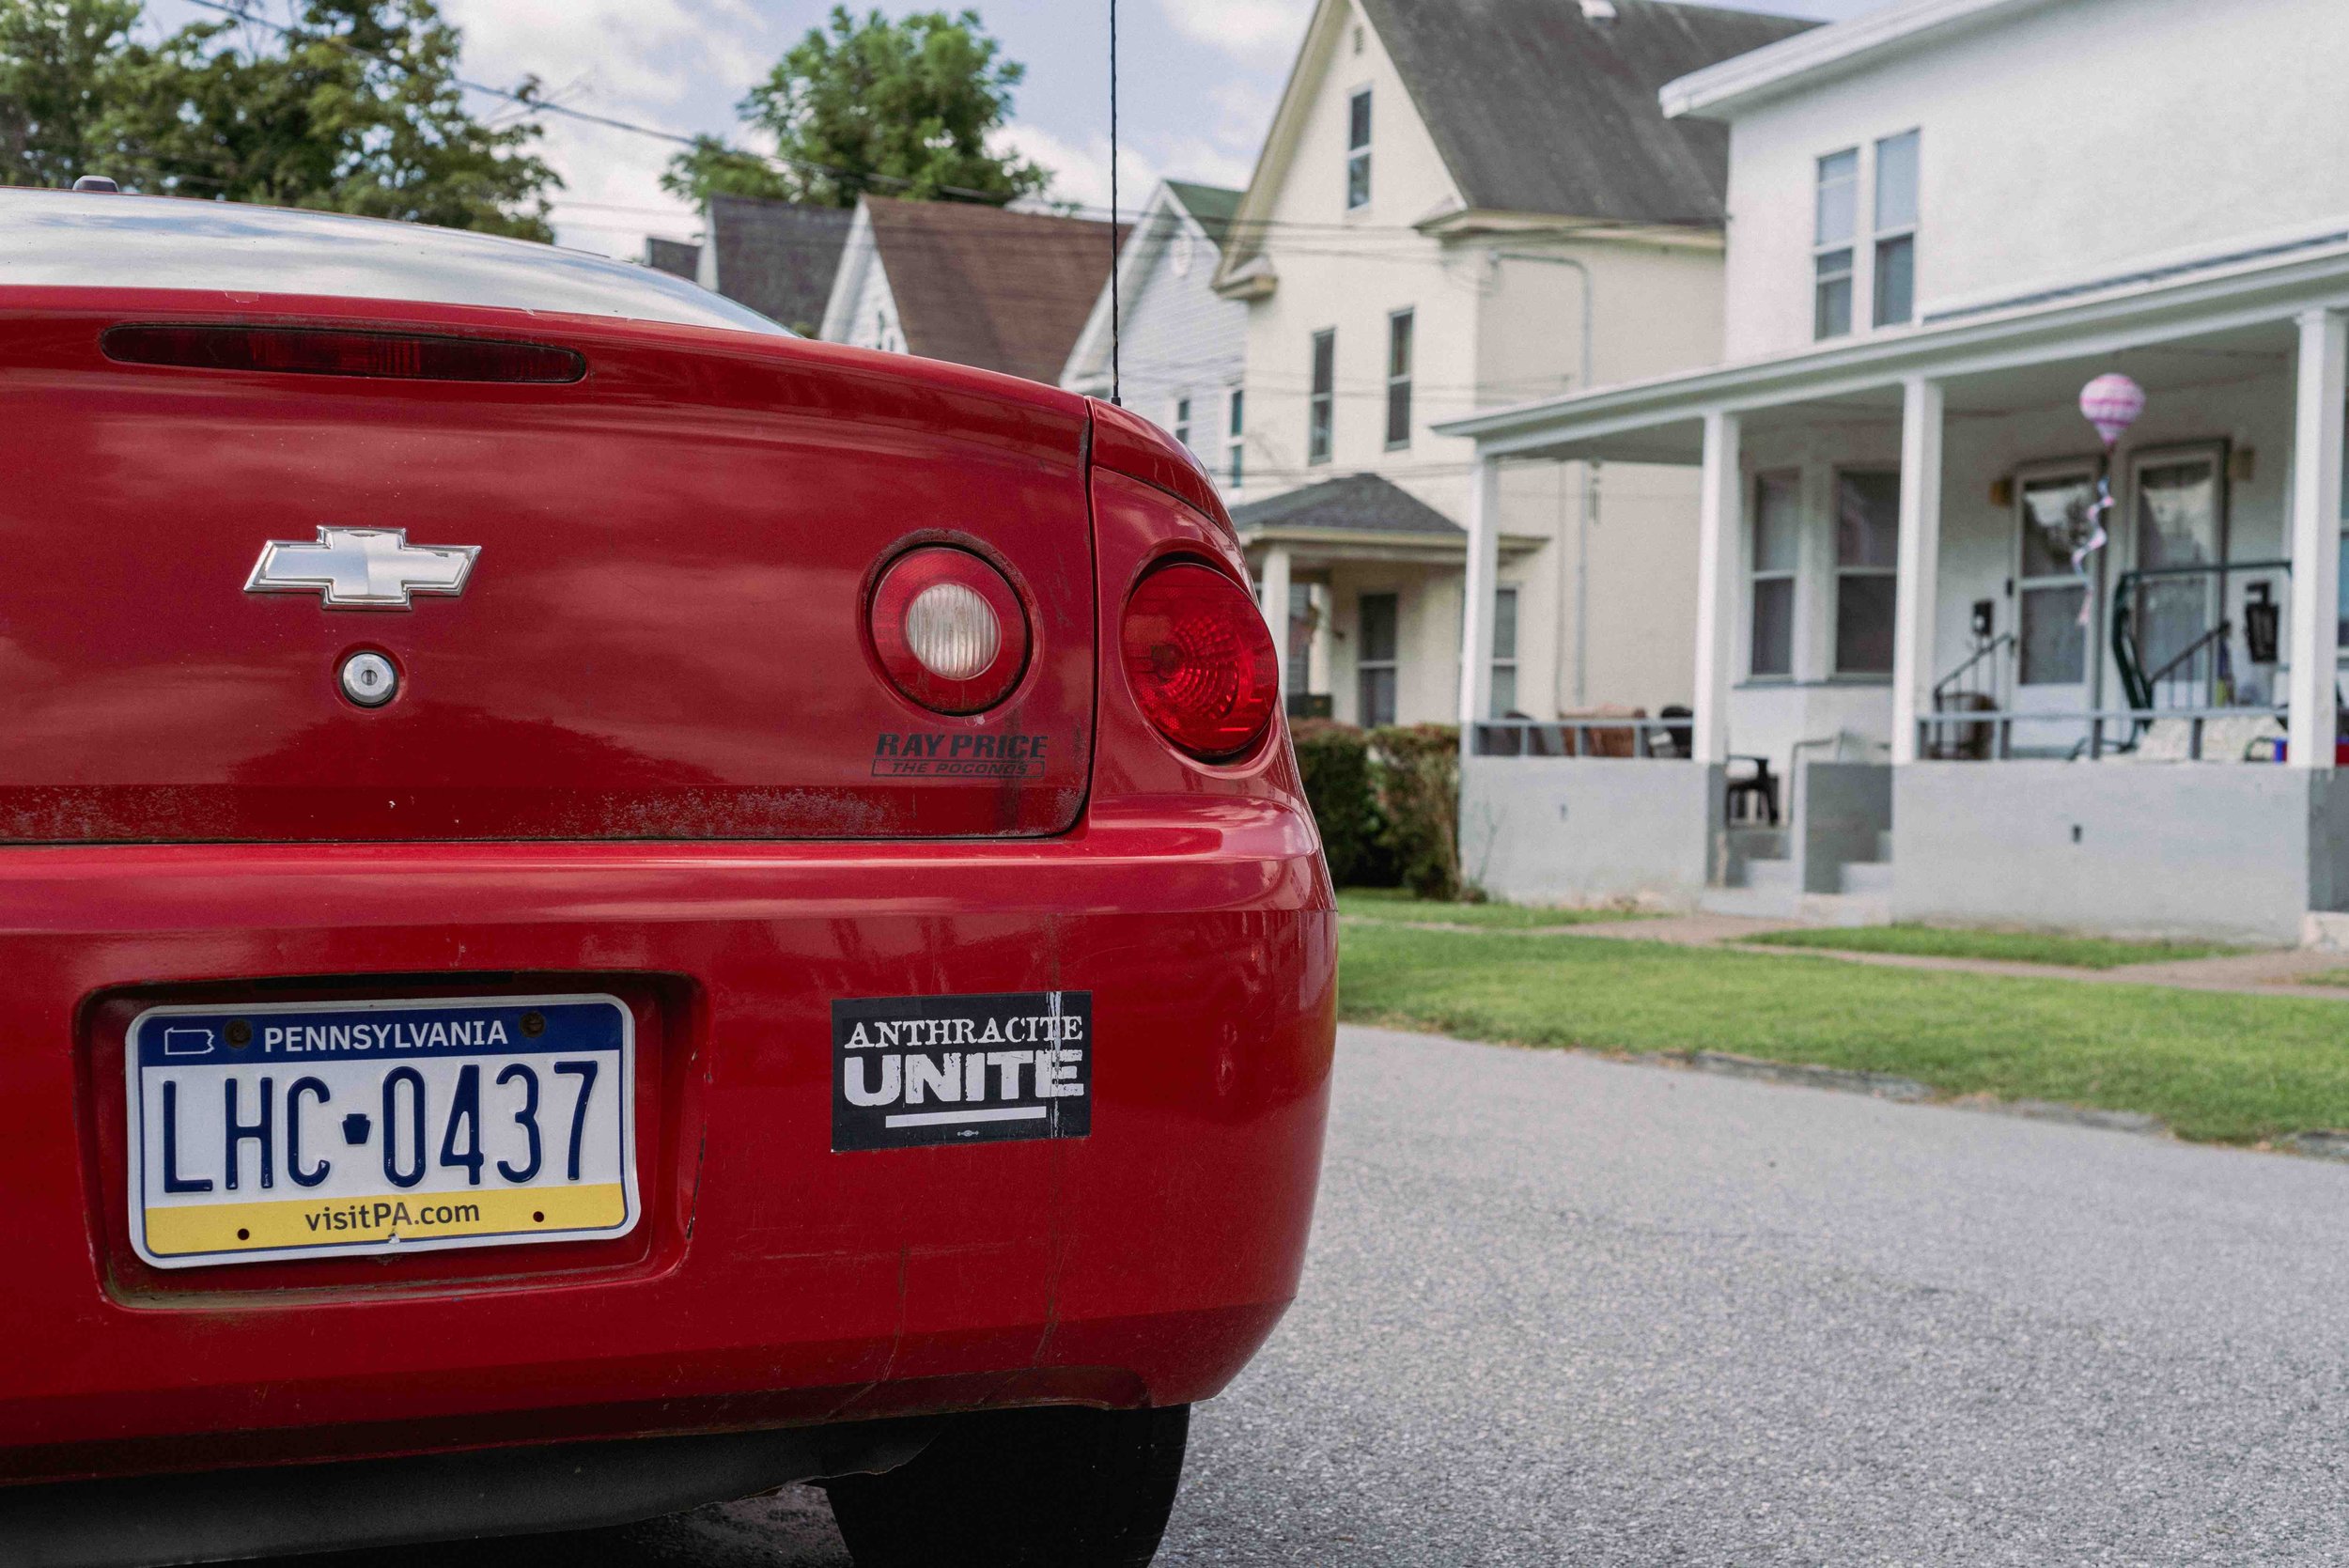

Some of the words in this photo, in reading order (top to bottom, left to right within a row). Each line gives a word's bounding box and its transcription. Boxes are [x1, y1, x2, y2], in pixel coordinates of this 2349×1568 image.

[876, 734, 944, 756] RAY
[949, 734, 1049, 758] PRICE
[892, 762, 927, 773] THE
[935, 762, 1028, 775] POCONOS
[264, 1020, 508, 1052] PENNSYLVANIA
[844, 1016, 1083, 1048] ANTHRACITE
[844, 1049, 1084, 1107] UNITE
[305, 1201, 480, 1232] visitPA.com
